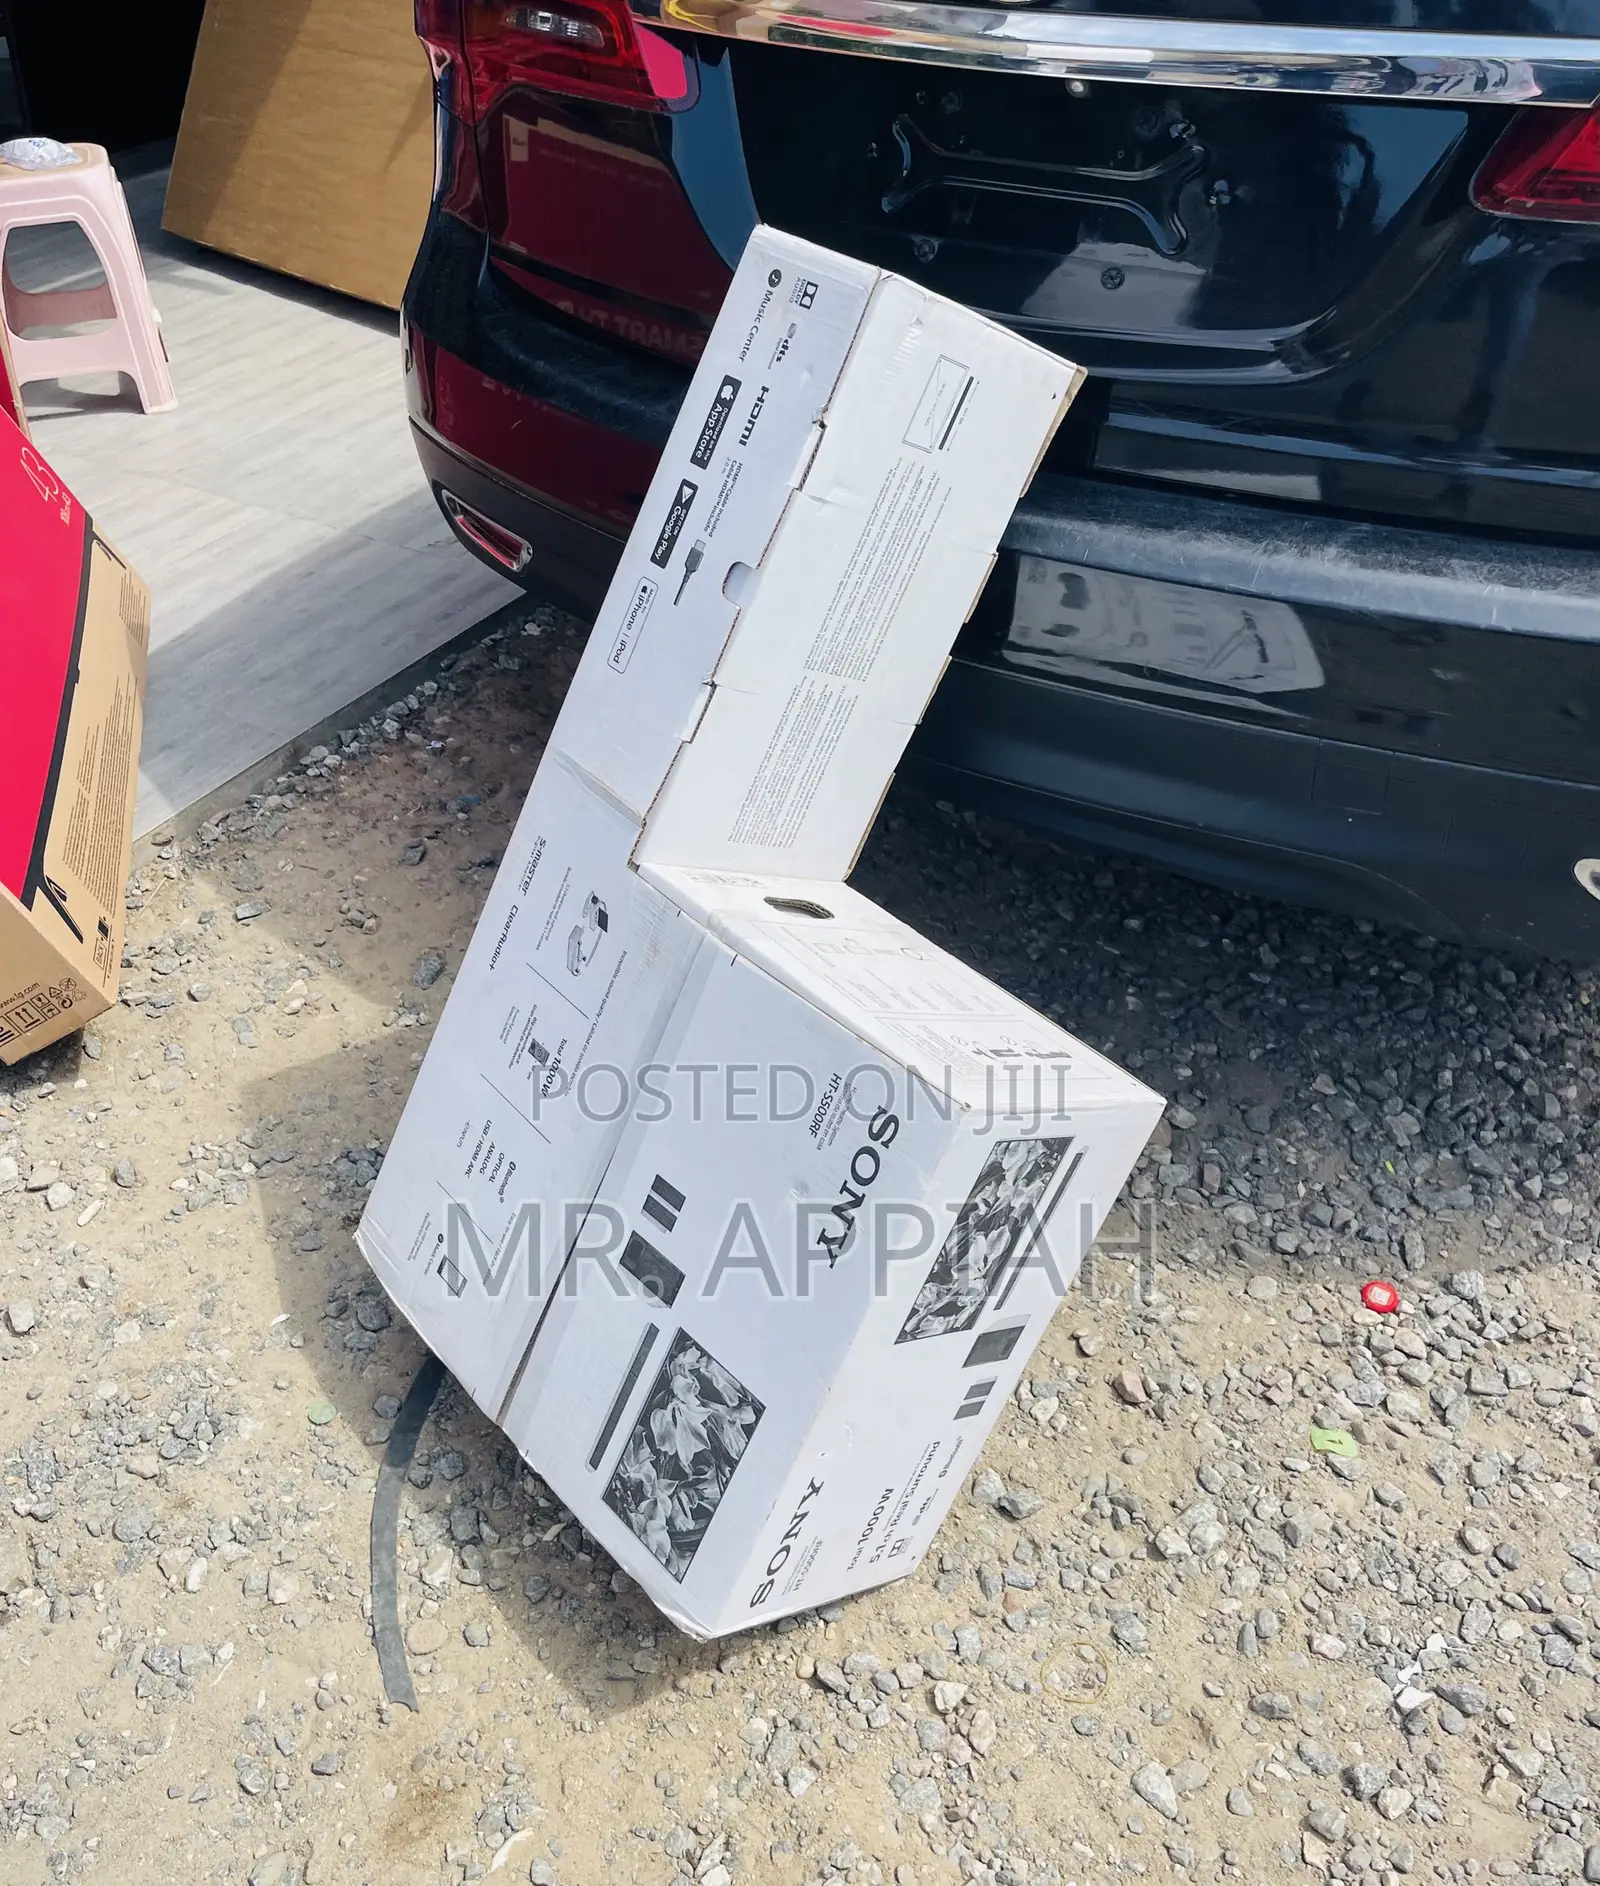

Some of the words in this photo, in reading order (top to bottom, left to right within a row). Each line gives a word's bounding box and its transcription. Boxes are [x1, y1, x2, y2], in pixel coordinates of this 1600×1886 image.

[788, 276, 802, 304] AUDIO
[794, 278, 807, 305] DOLBY
[754, 289, 774, 323] Music
[739, 325, 759, 362] Center
[775, 338, 789, 362] dts
[708, 403, 723, 428] App
[712, 407, 729, 440] Download
[738, 385, 770, 446] HDMI
[695, 428, 713, 458] Store
[703, 449, 711, 461] the
[708, 440, 715, 449] on
[20, 446, 59, 502] 43
[725, 459, 738, 480] Cable
[721, 488, 732, 508] Cable
[663, 505, 682, 540] Google
[708, 508, 724, 538] included
[654, 539, 668, 560] Play
[626, 594, 645, 631] iPhone
[612, 639, 628, 664] iPod
[489, 904, 519, 970] ClearAudio+
[612, 950, 628, 980] Incredible
[604, 979, 615, 999] sound
[529, 1004, 538, 1018] Gran
[595, 997, 607, 1019] quality
[585, 1022, 598, 1046] Calidad
[556, 1038, 568, 1057] Total
[573, 1052, 585, 1073] sonido
[809, 1073, 842, 1138] HT-S500RF
[482, 1119, 493, 1136] USB
[827, 1125, 840, 1147] System
[471, 1139, 484, 1162] HDMI
[479, 1141, 496, 1175] ANALOG
[464, 1161, 474, 1179] ARC
[488, 1152, 505, 1183] OPTICAL
[817, 1107, 899, 1267] SONY
[430, 1242, 441, 1258] Music
[423, 1258, 434, 1276] Center
[889, 1500, 910, 1527] Real
[905, 1441, 941, 1498] Surround
[750, 1478, 824, 1608] SONY
[846, 1546, 864, 1571] Total
